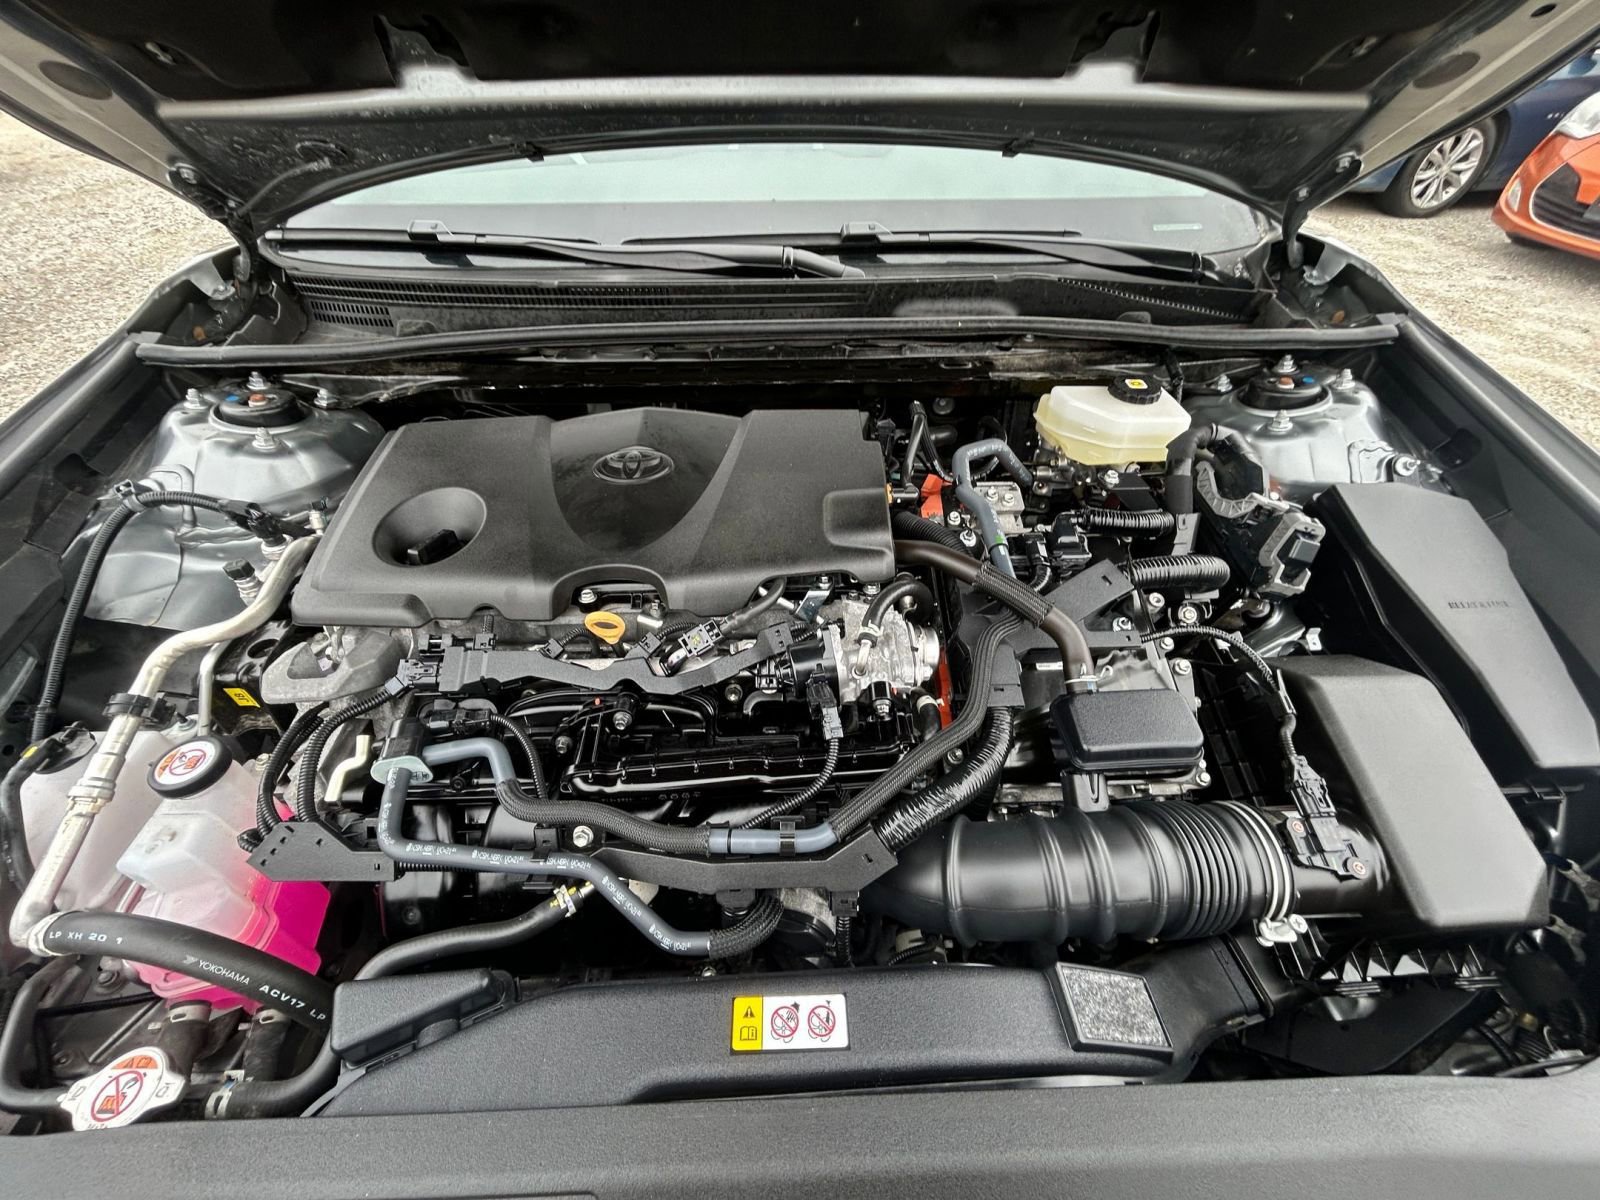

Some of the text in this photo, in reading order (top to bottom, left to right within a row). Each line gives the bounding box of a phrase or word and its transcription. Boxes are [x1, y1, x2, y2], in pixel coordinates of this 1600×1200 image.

[49, 931, 62, 939] LP
[67, 931, 83, 940] XH
[116, 937, 123, 945] 1
[198, 959, 327, 1021] YOKOHAMA ACV17 LP
